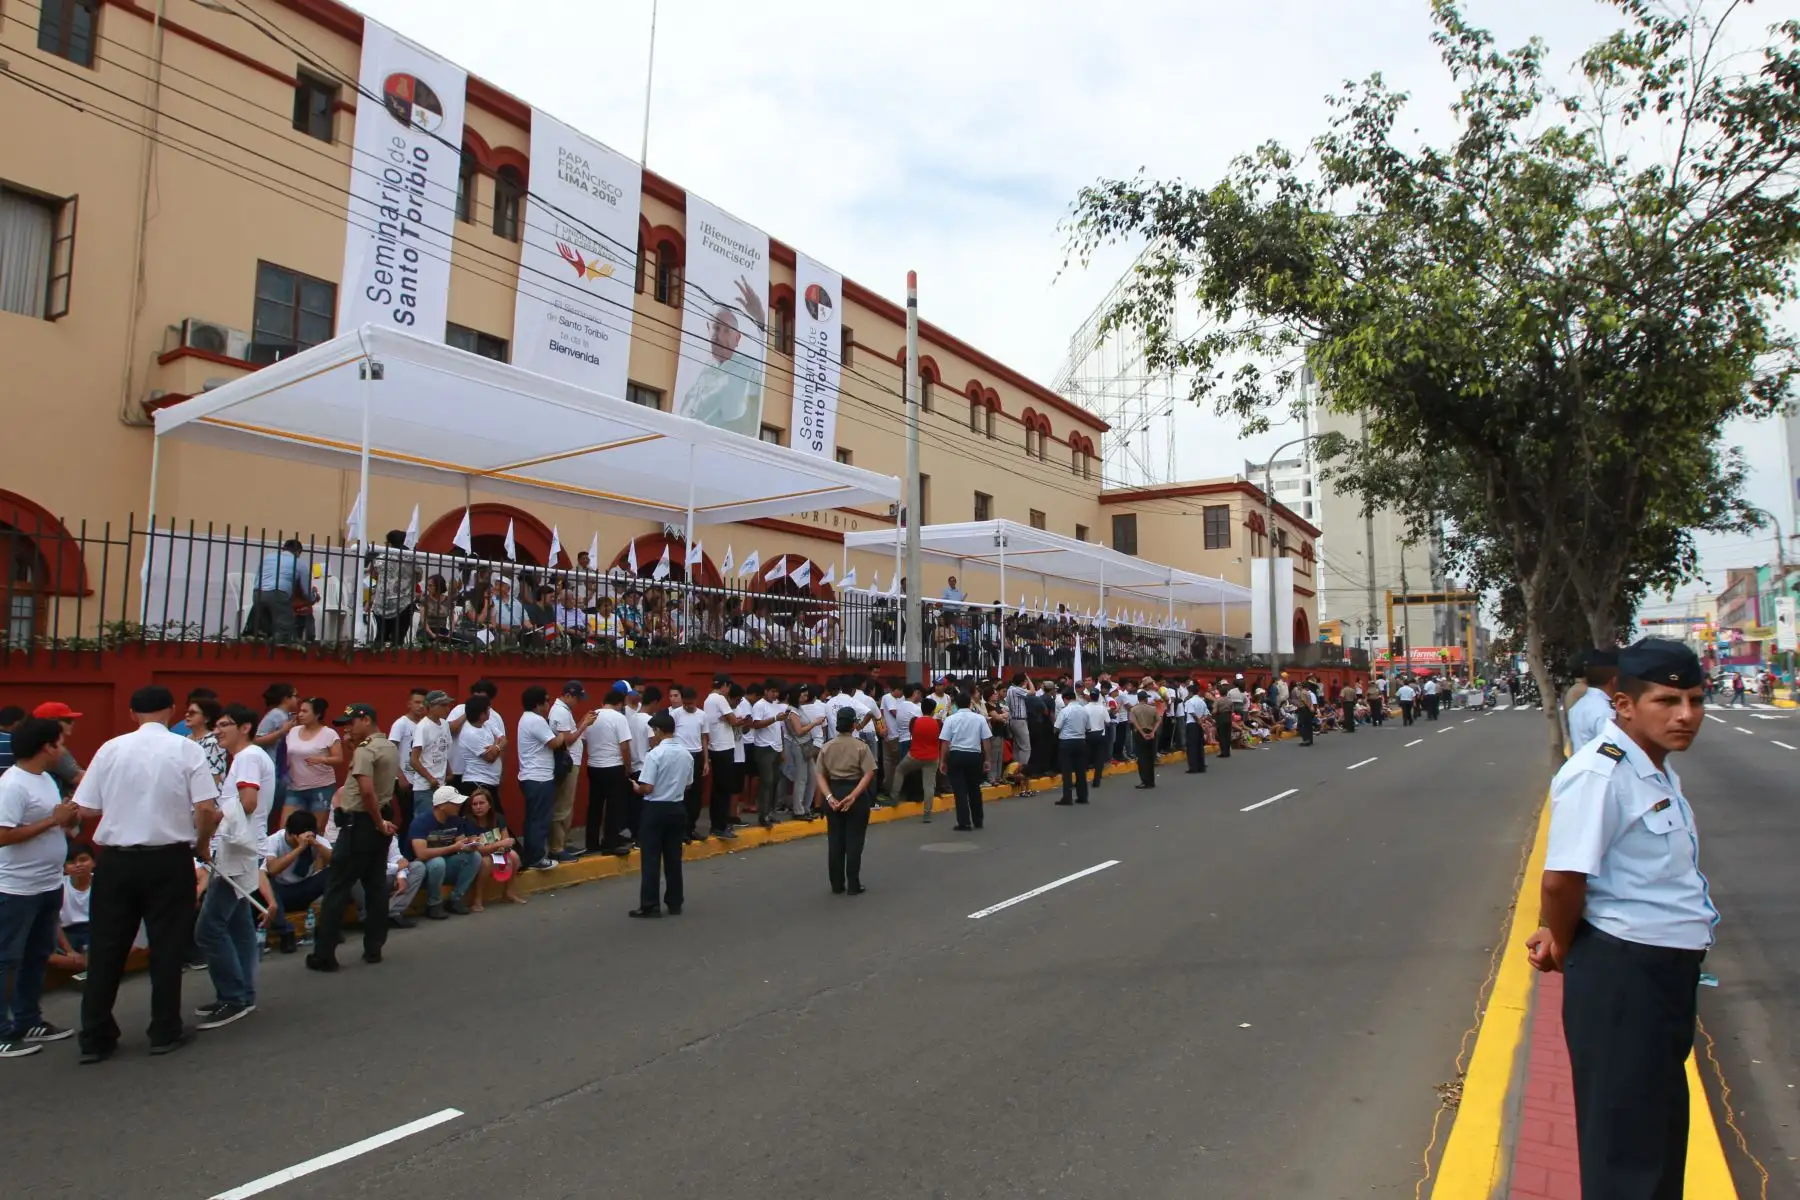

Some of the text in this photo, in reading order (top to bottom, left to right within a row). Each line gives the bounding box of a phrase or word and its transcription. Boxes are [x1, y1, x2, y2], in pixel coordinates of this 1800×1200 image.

[558, 147, 590, 170] PAPA
[558, 158, 623, 198] FRANCISCO
[558, 169, 617, 206] LIMA 2018
[366, 136, 407, 305] Seminario de
[393, 147, 429, 326] Santo Toribio
[702, 234, 755, 271] Francisco!
[558, 316, 582, 331] Santo
[584, 325, 609, 341] Toribio
[549, 339, 600, 365] Bienvenida
[800, 347, 816, 440] Seminario
[812, 331, 828, 452] Santo Toribio
[791, 511, 858, 530] ORIBIO
